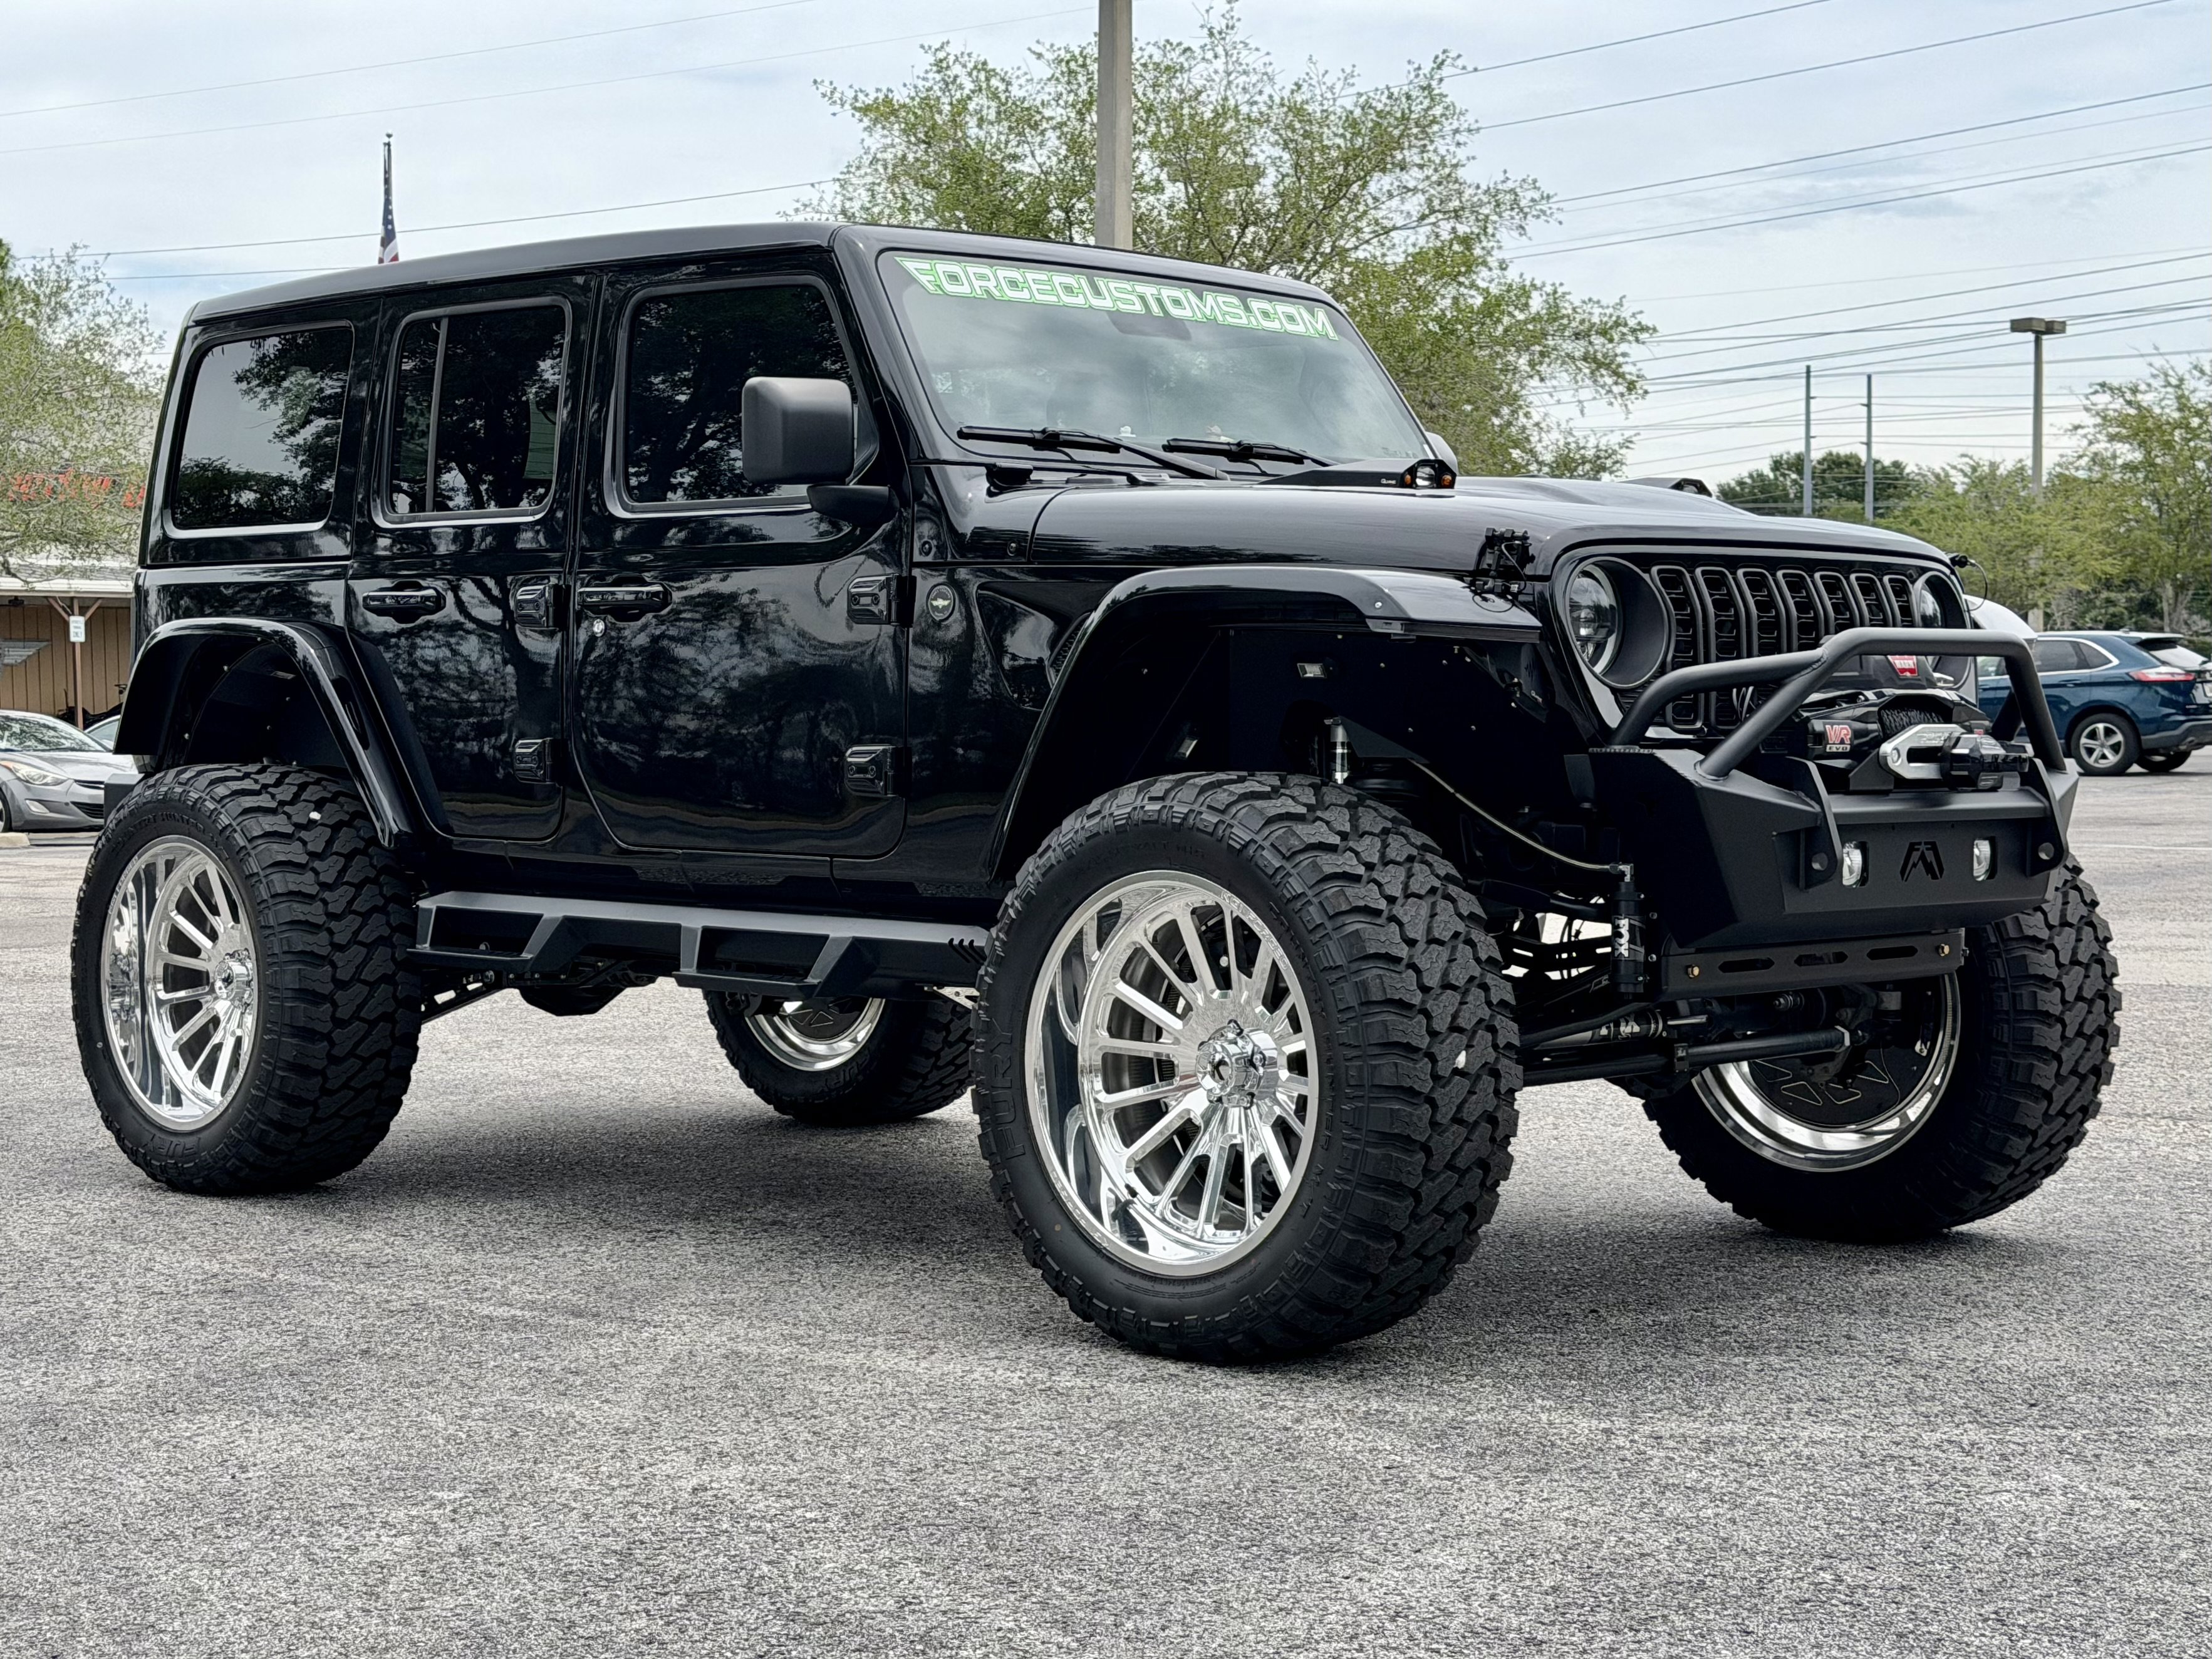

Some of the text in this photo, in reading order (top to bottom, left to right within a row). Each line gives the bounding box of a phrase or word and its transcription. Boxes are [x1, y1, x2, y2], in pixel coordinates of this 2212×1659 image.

[895, 257, 1339, 341] FORCECUSTOMS.COM
[1825, 724, 1852, 744] VR
[1614, 917, 1630, 958] FOX
[989, 1017, 1026, 1161] FURY
